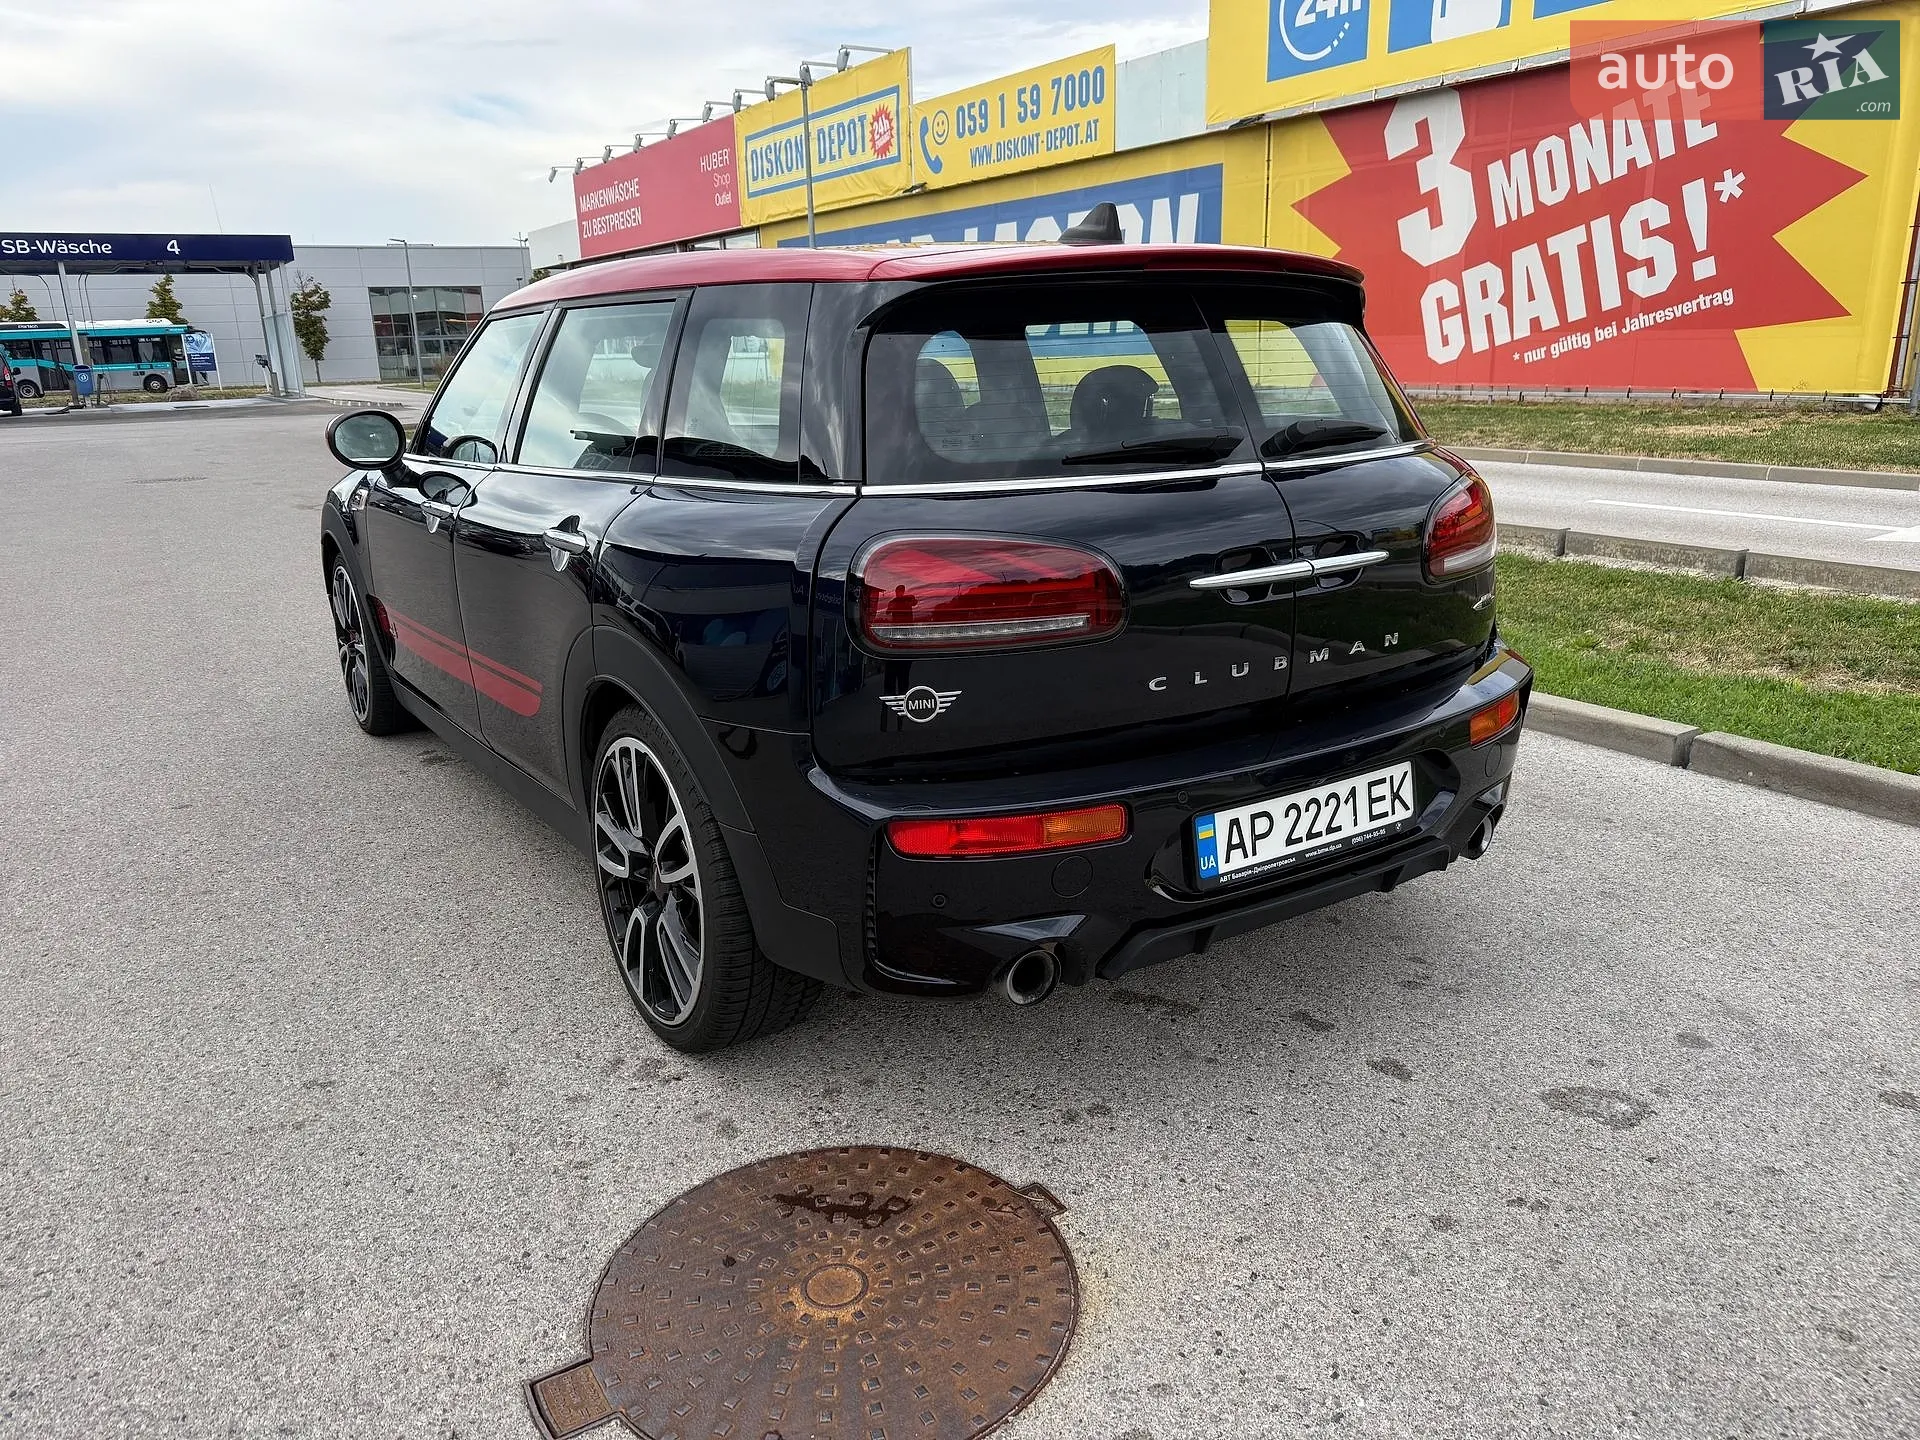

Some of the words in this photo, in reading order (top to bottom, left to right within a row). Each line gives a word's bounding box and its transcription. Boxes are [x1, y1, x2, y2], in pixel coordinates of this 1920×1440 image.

[956, 98, 988, 139] 059
[998, 93, 1005, 129] 1
[1017, 83, 1041, 123] 59
[1051, 65, 1105, 115] 7000
[816, 114, 867, 165] DEPOT
[713, 172, 731, 188] Shop
[1384, 86, 1479, 267] 3
[1487, 66, 1718, 228] MONATE
[580, 177, 640, 213] MARKENWÄSCHE
[582, 219, 592, 239] ZU
[592, 206, 642, 236] BESTPREISEN
[1, 239, 112, 254] SB-Wäsche
[166, 239, 181, 254] 4
[1550, 331, 1592, 358] gültig
[1594, 321, 1617, 342] bei
[1621, 287, 1735, 334] Jahresvertrag
[907, 698, 935, 711] MINI
[1225, 810, 1274, 865] AP
[1284, 786, 1358, 847] 2221
[1367, 770, 1411, 823] EK
[1200, 855, 1217, 870] UA
